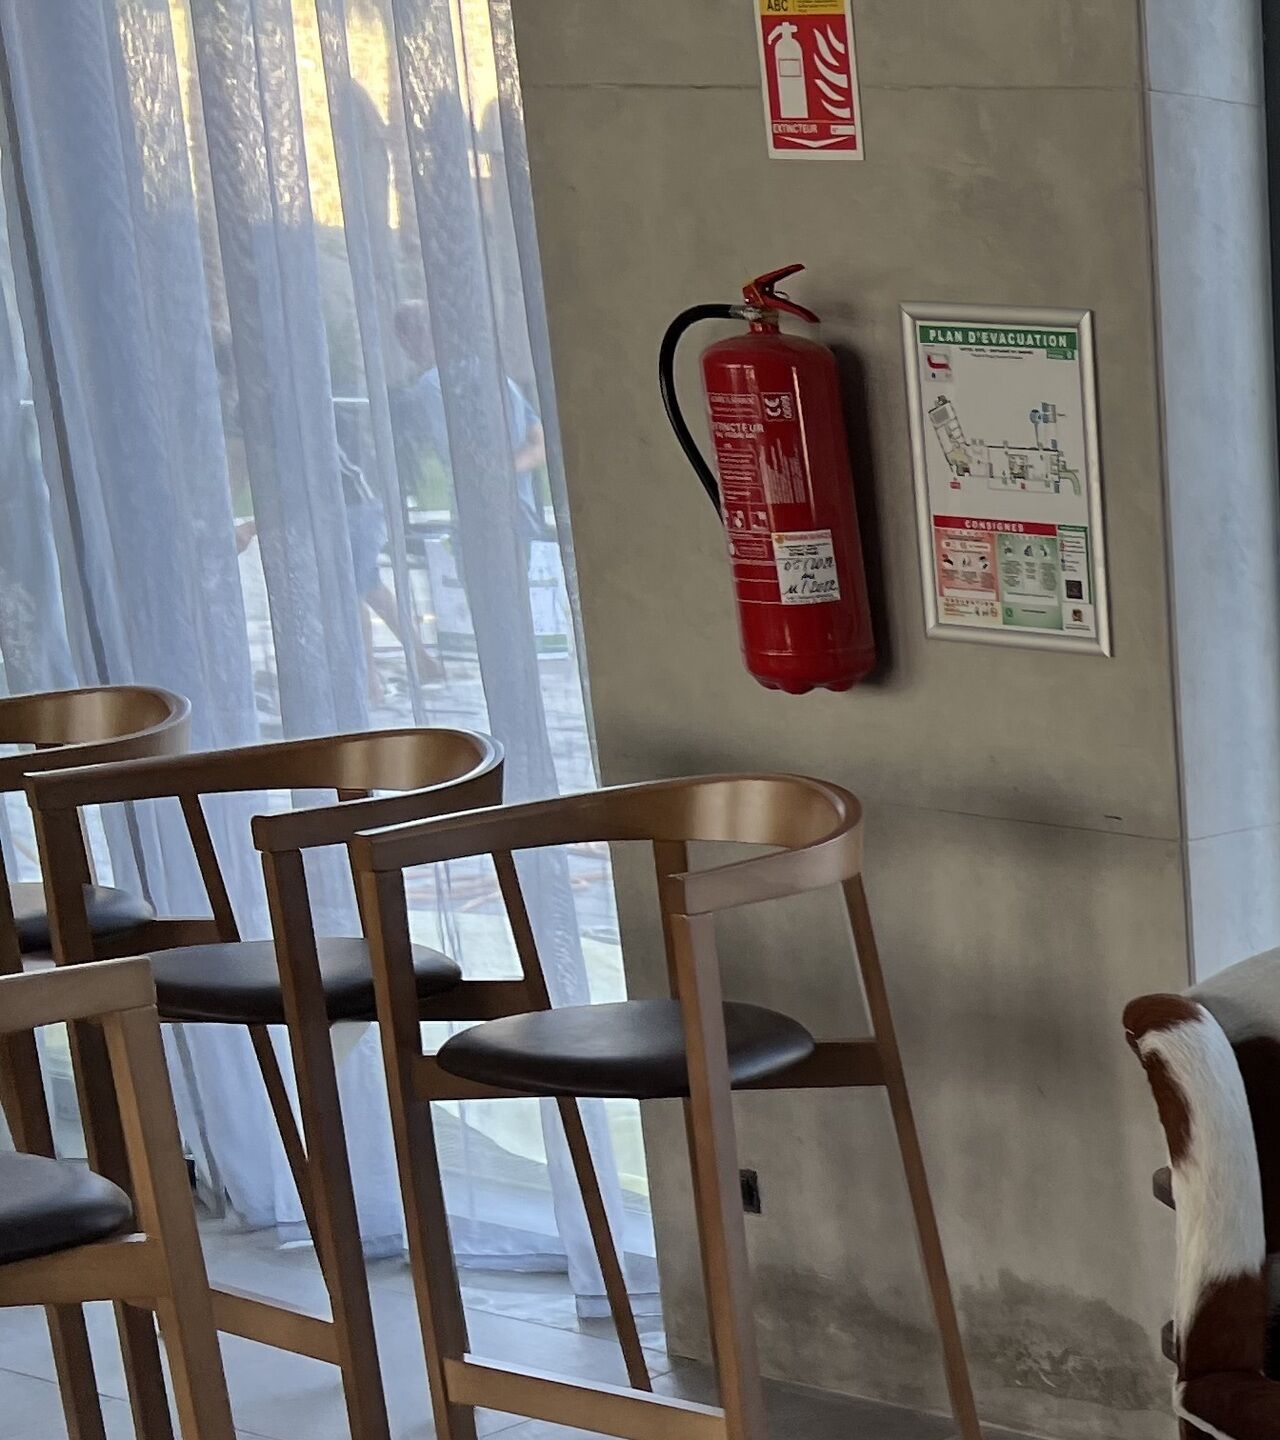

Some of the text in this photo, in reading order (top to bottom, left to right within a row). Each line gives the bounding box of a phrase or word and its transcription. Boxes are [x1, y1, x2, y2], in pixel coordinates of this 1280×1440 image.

[767, 0, 788, 12] ABC
[773, 123, 818, 134] EXTINCTEUR
[929, 329, 1068, 348] PLAN D'EVACUATION
[964, 519, 1025, 533] CONSIGNES
